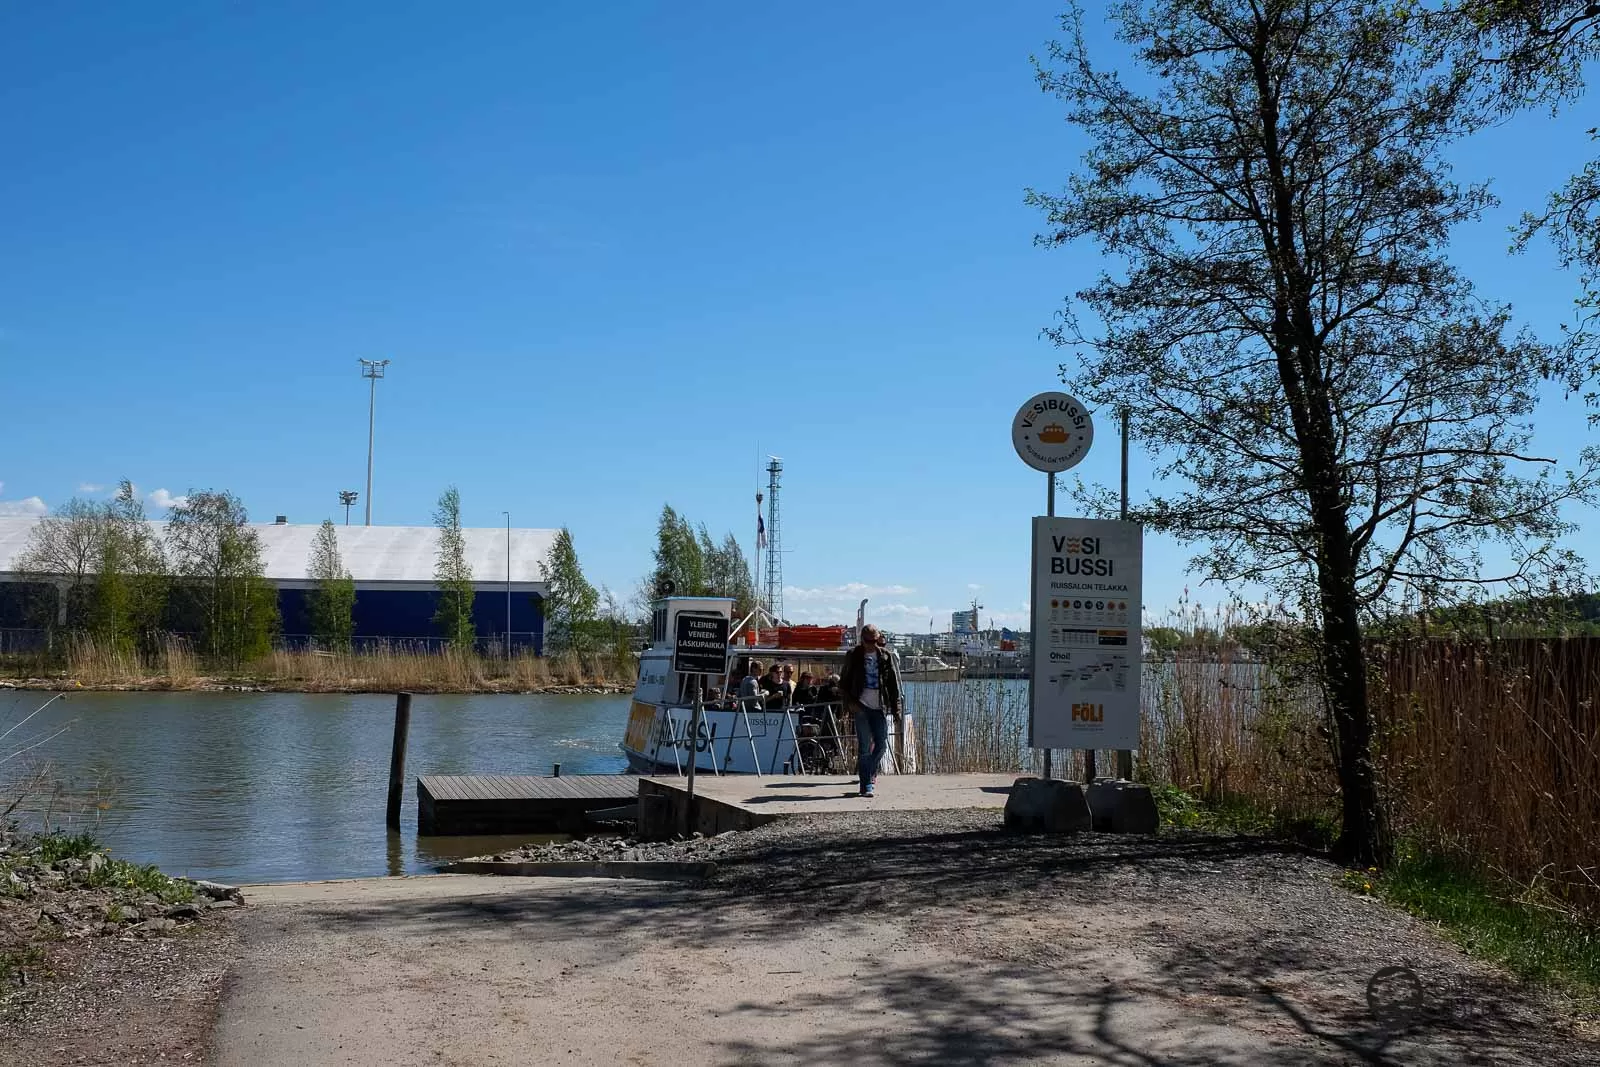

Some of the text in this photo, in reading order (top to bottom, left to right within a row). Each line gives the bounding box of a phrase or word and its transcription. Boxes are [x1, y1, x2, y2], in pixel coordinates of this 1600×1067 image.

[1021, 399, 1086, 430] VESIBUSSI
[1051, 535, 1101, 555] VESI
[1050, 556, 1114, 577] BUSSI
[1050, 581, 1128, 592] RUISSALON TELAKKA
[689, 620, 718, 629] YLEINEN
[688, 630, 718, 639] VENEEN-
[678, 639, 725, 649] LASKUPAIKKA
[1049, 651, 1071, 661] Ohoi!
[1071, 702, 1104, 722] FÖLI
